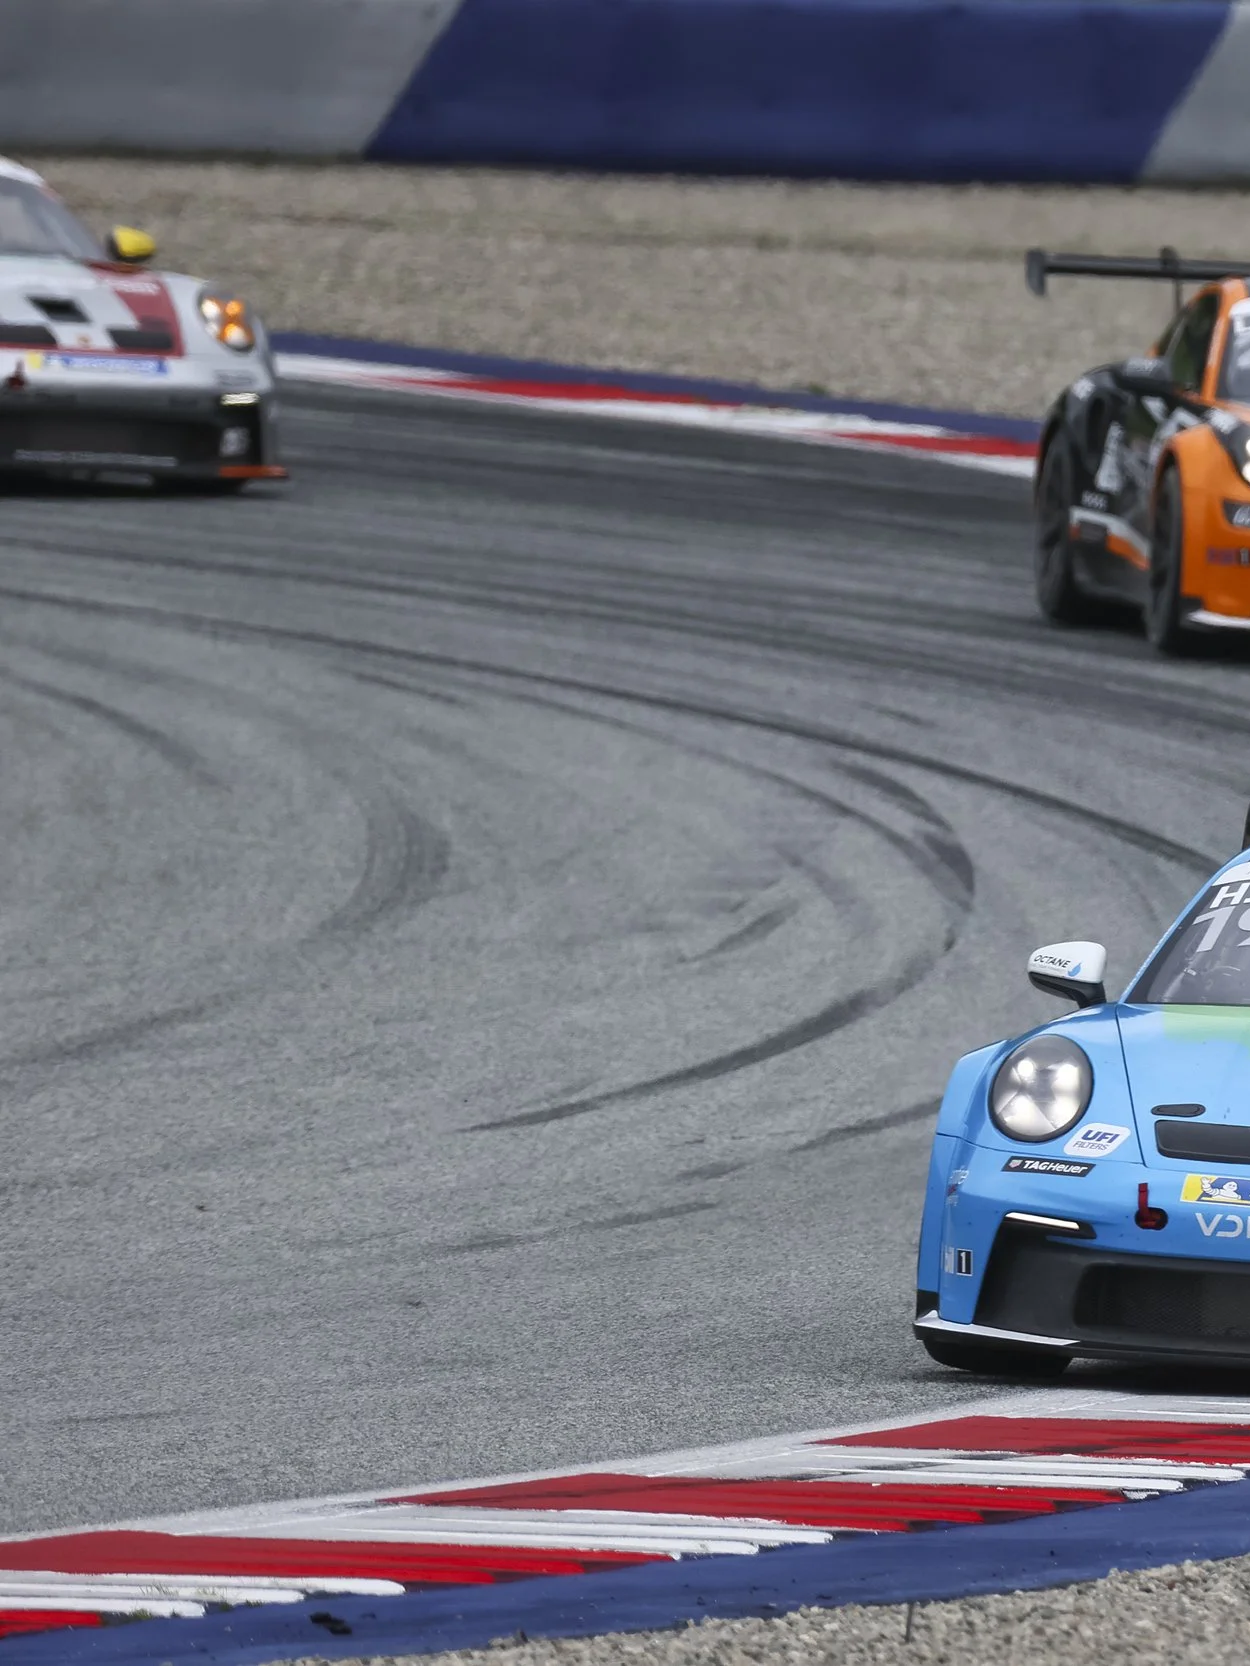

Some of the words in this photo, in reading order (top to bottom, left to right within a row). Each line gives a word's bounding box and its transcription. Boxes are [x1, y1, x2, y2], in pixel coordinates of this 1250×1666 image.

[1033, 954, 1071, 969] OCTANE
[1081, 1129, 1121, 1144] UFI
[1072, 1140, 1110, 1151] FILTERS
